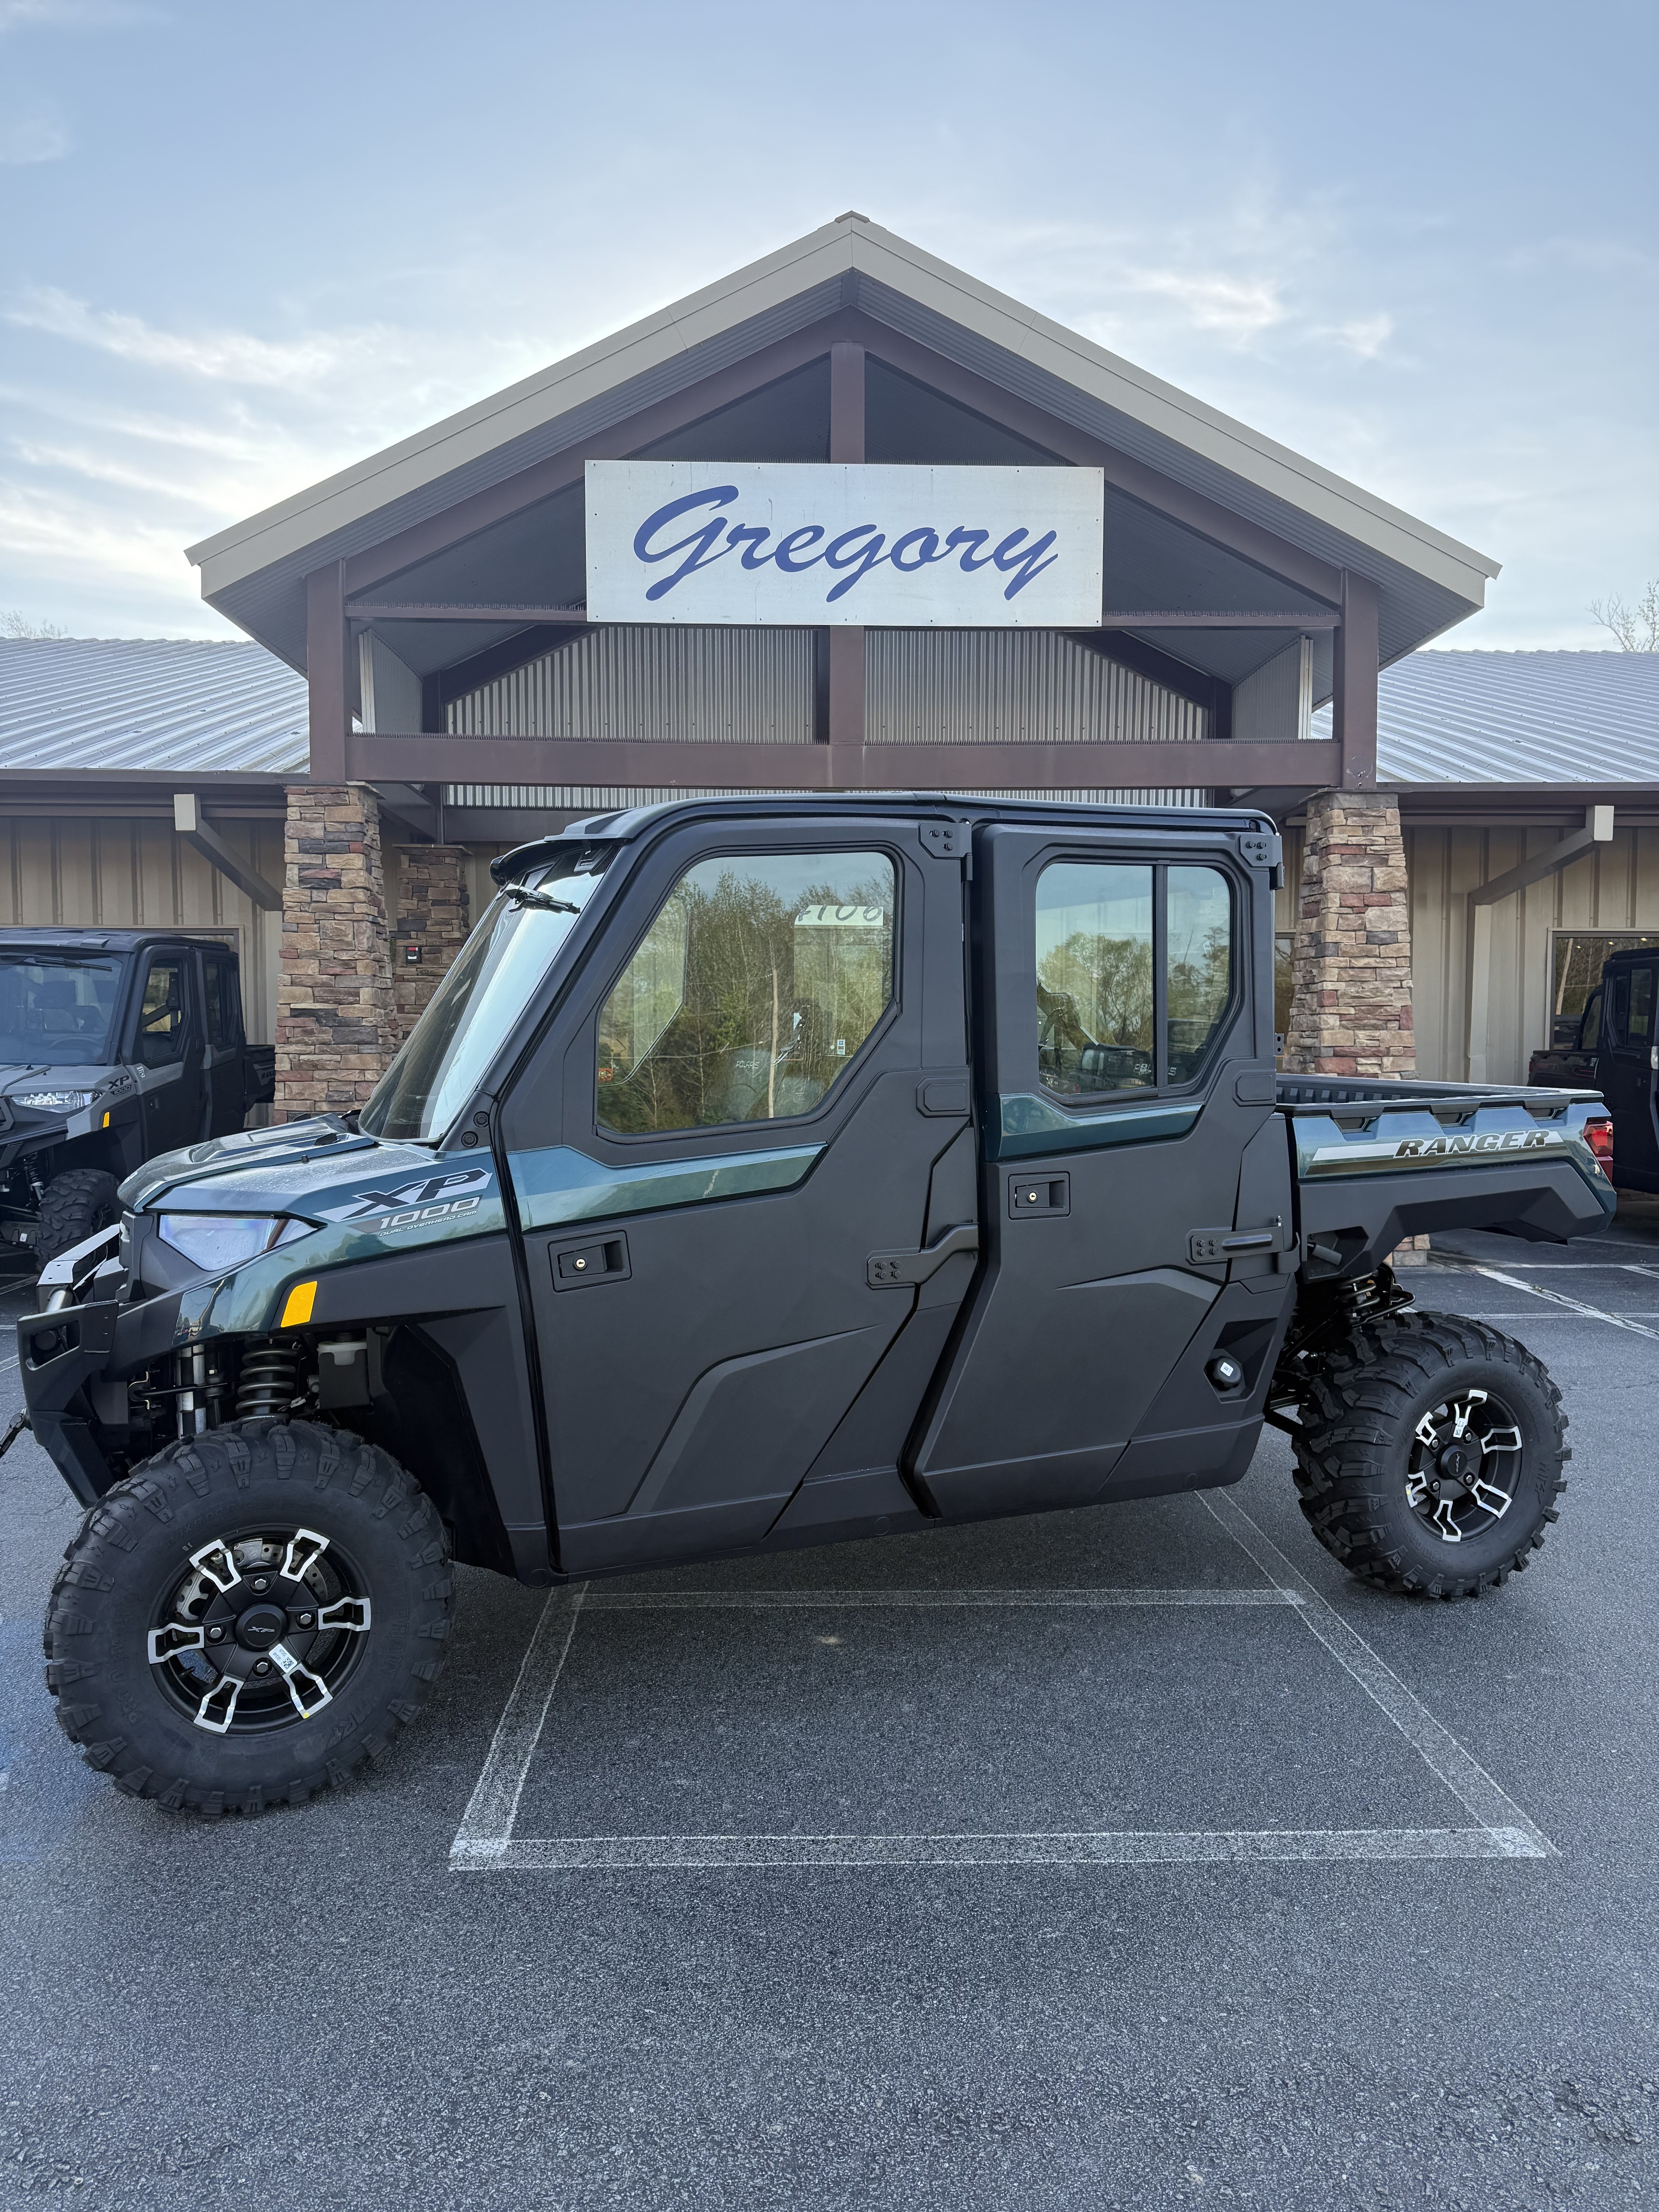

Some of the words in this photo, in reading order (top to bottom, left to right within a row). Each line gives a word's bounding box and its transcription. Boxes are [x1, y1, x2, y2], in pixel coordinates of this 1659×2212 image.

[633, 485, 1058, 603] Gregory
[736, 1061, 759, 1069] POLARIS
[108, 1075, 130, 1090] XP
[114, 1085, 131, 1095] 1000
[1394, 1130, 1550, 1158] RANGER
[340, 1168, 488, 1221] XP
[379, 1228, 404, 1237] DUAL
[407, 1215, 455, 1230] OVERHEAD
[457, 1210, 477, 1218] CAM
[380, 1196, 480, 1229] 1000
